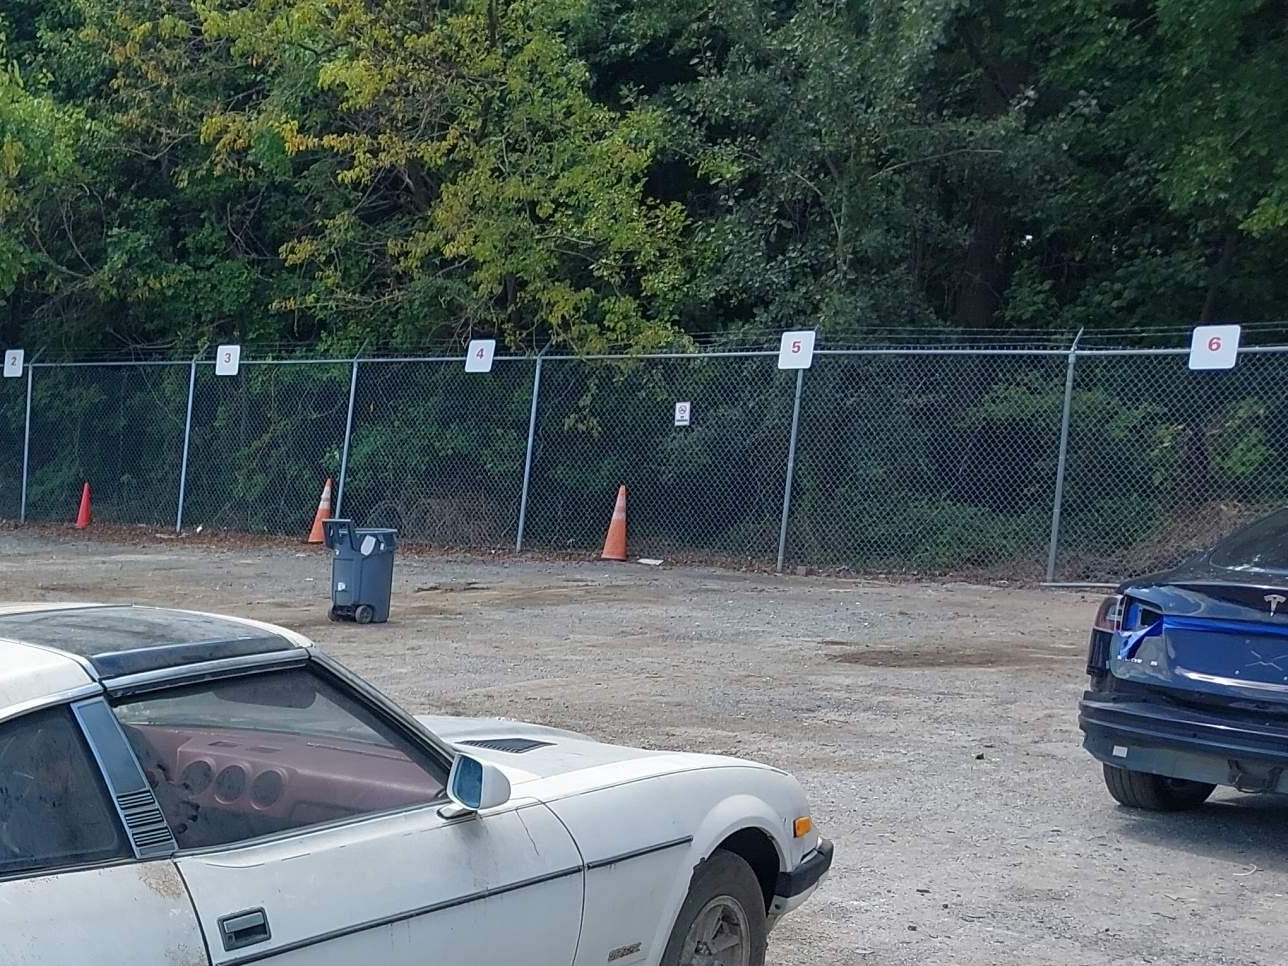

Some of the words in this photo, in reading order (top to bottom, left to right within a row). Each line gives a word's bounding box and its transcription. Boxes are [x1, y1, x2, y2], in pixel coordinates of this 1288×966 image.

[792, 341, 801, 353] 5
[1208, 337, 1221, 351] 6
[224, 352, 231, 363] 3
[476, 348, 484, 359] 4
[11, 356, 17, 366] 2
